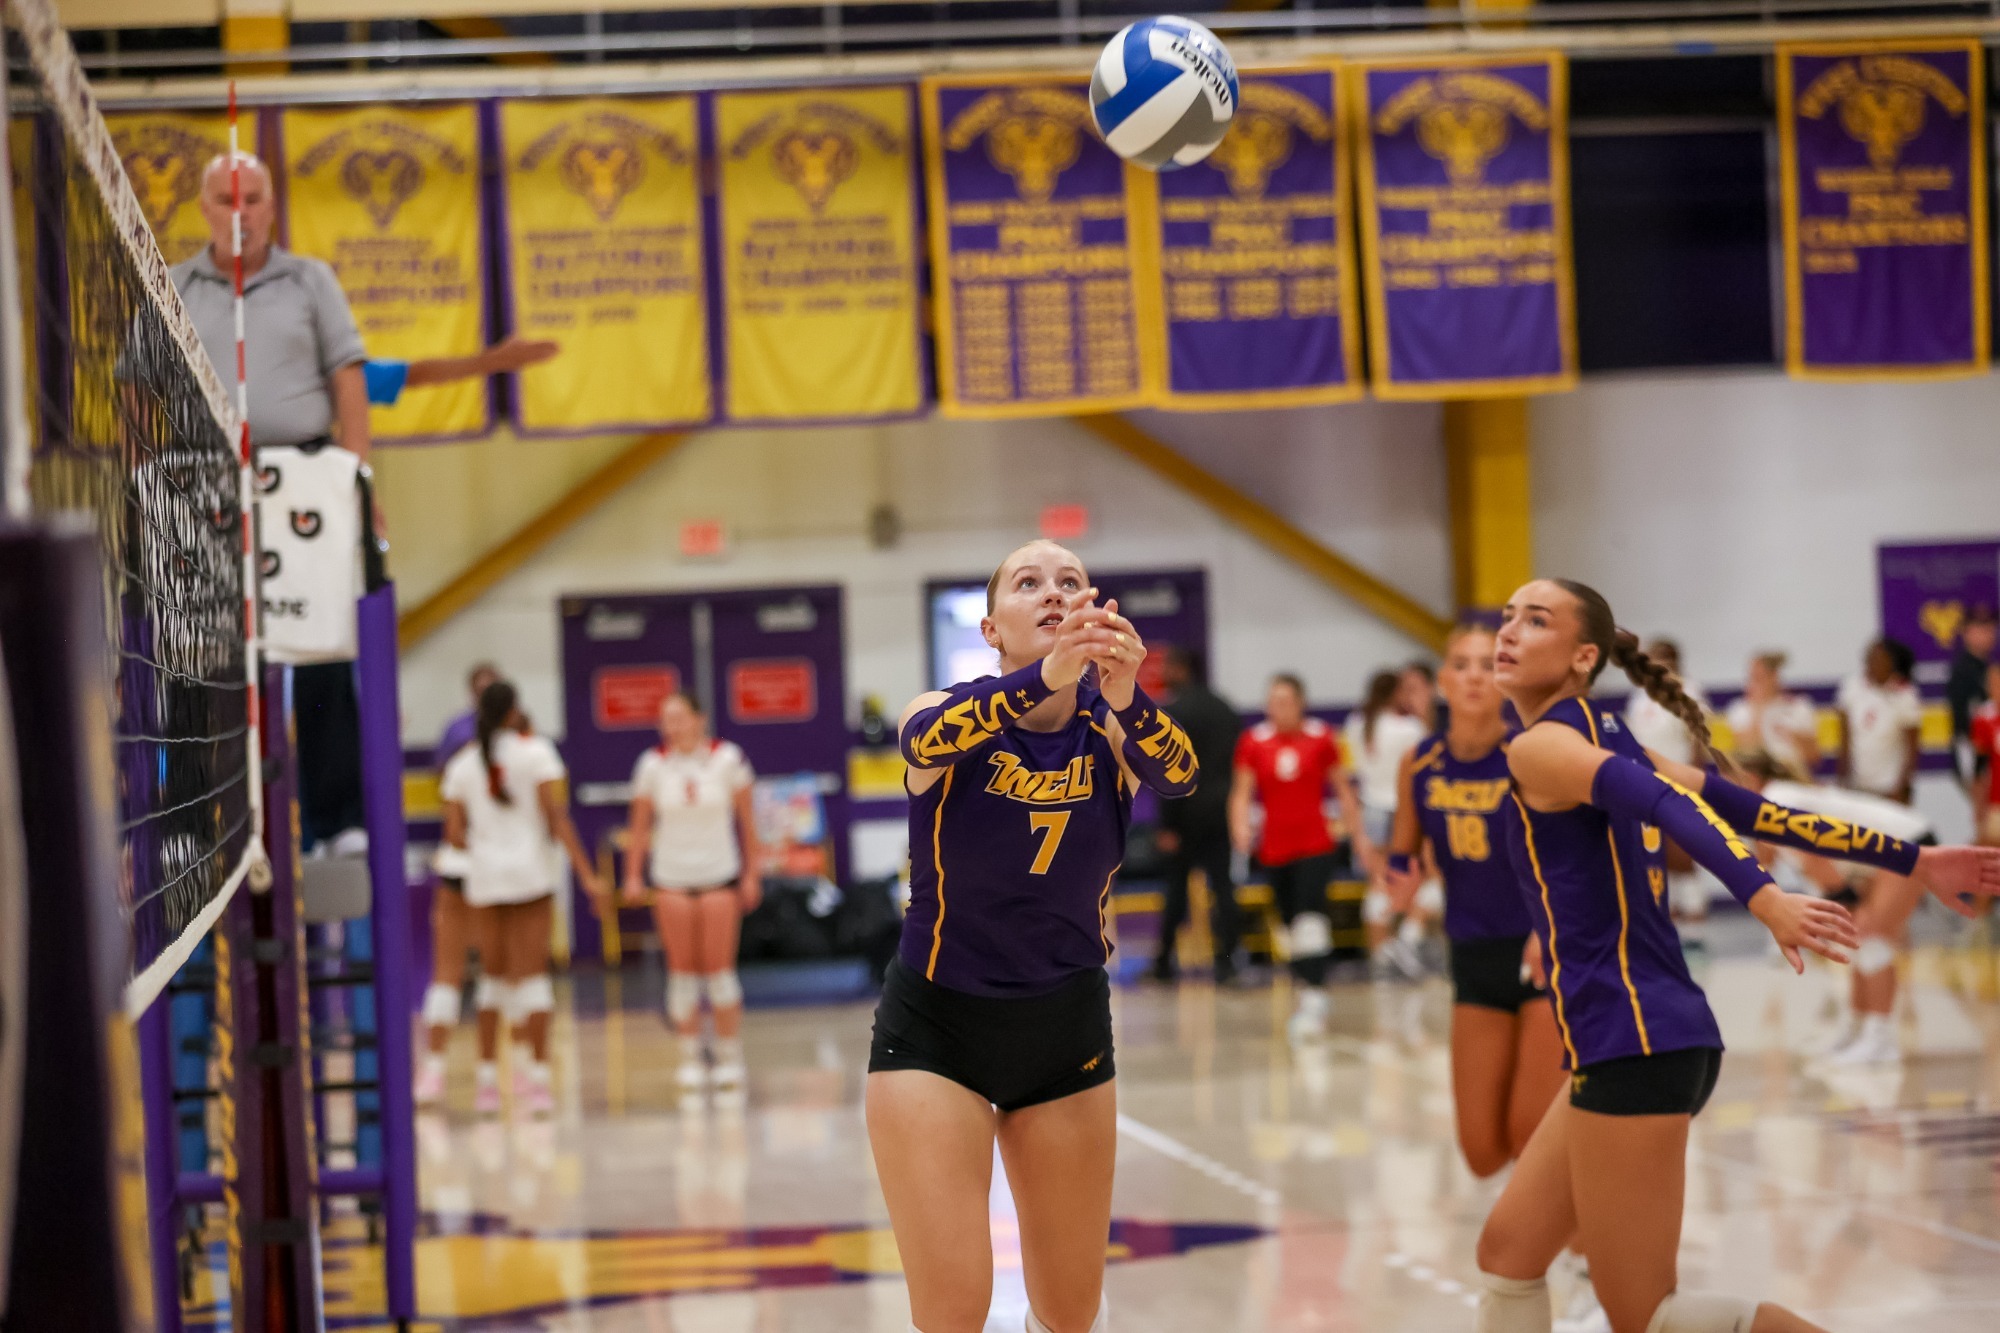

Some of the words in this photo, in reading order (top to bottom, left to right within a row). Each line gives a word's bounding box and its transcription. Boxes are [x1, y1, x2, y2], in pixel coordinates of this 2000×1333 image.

[1169, 37, 1229, 106] molten
[1028, 810, 1072, 875] 7
[1446, 813, 1491, 861] 18
[1753, 802, 1884, 853] RAMS
